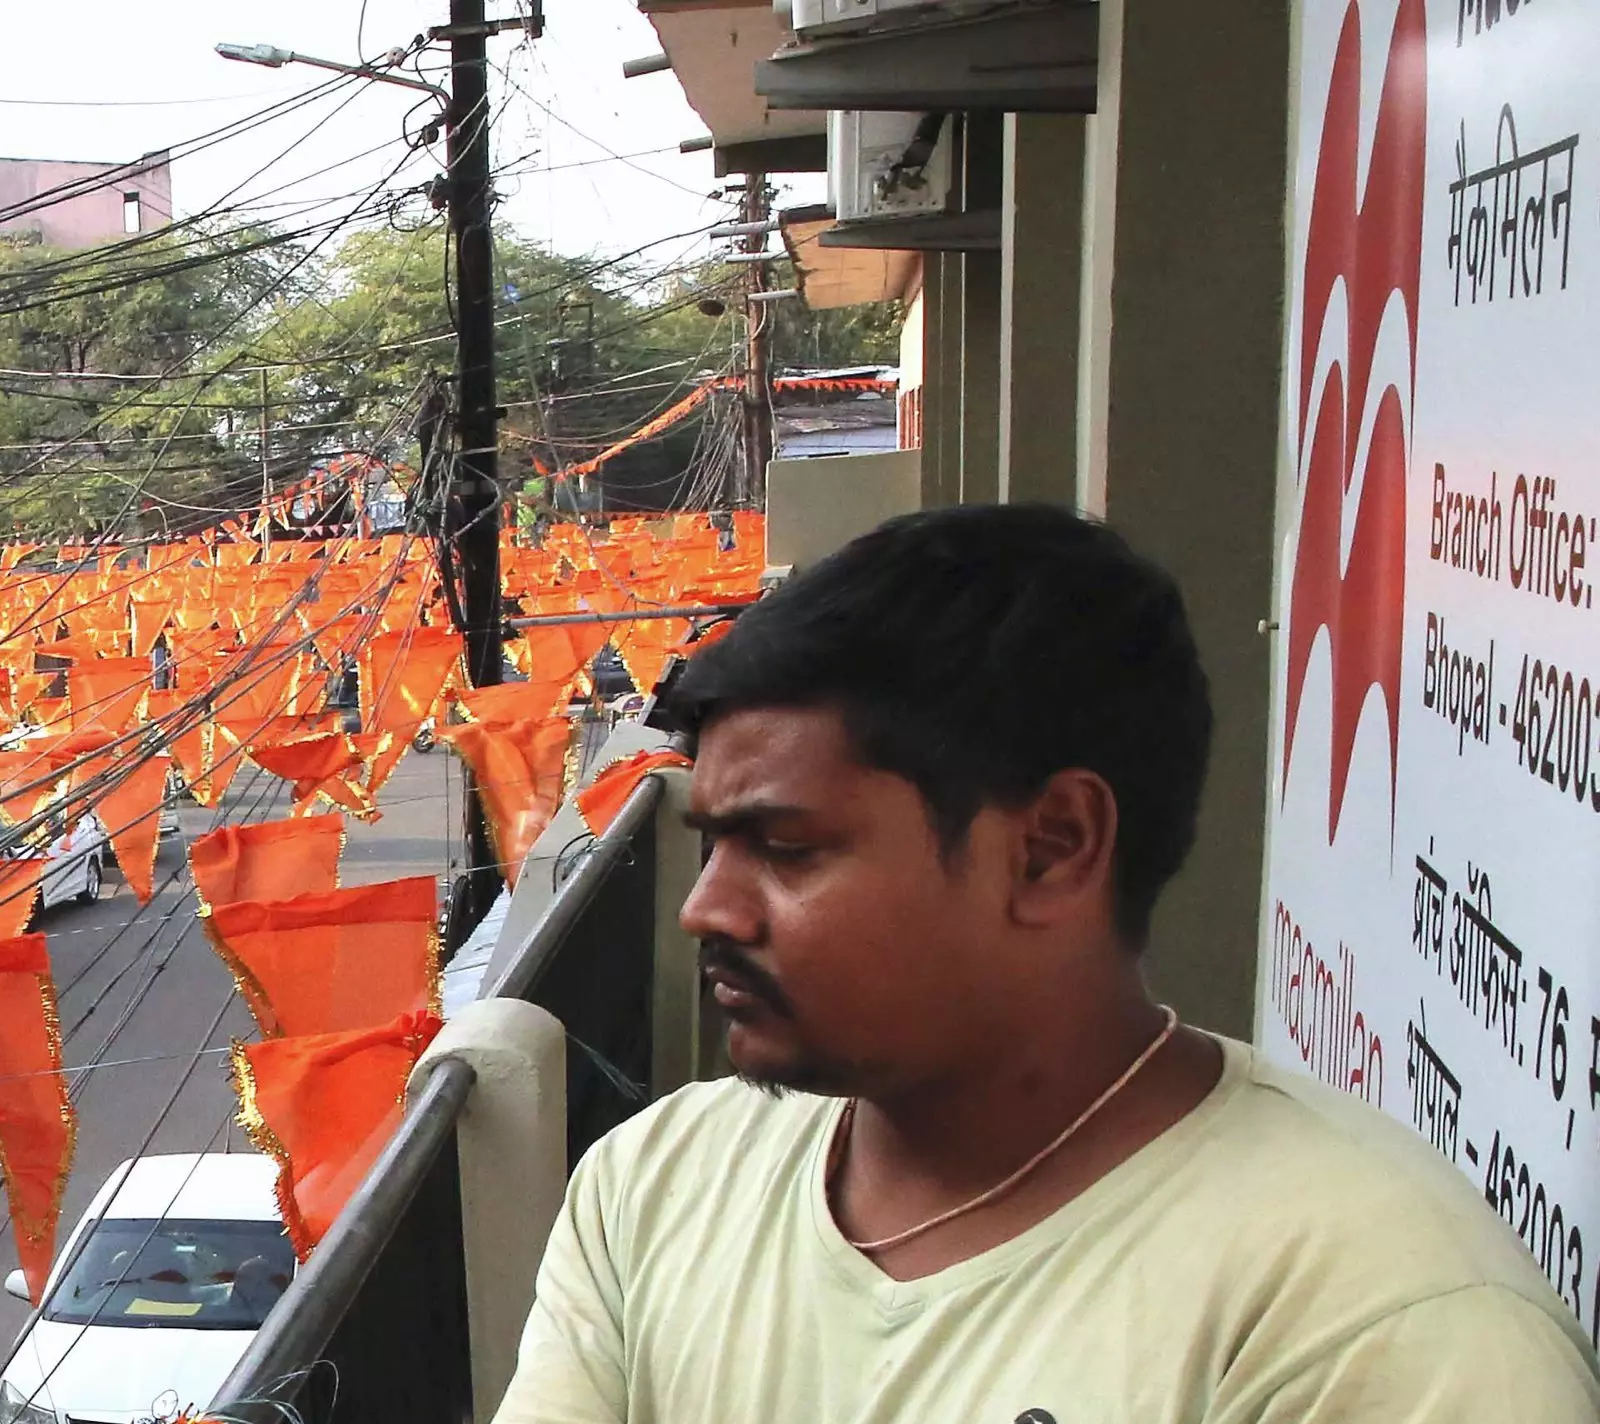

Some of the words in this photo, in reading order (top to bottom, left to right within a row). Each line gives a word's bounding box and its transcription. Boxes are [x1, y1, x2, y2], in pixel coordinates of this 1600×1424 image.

[1448, 103, 1580, 307] मैकमिलन
[1430, 462, 1501, 581] Branch
[1509, 473, 1597, 609] Office:
[1424, 611, 1494, 756] Bhopal
[1272, 898, 1384, 1110] macmillan
[1407, 996, 1462, 1164] भोपाल
